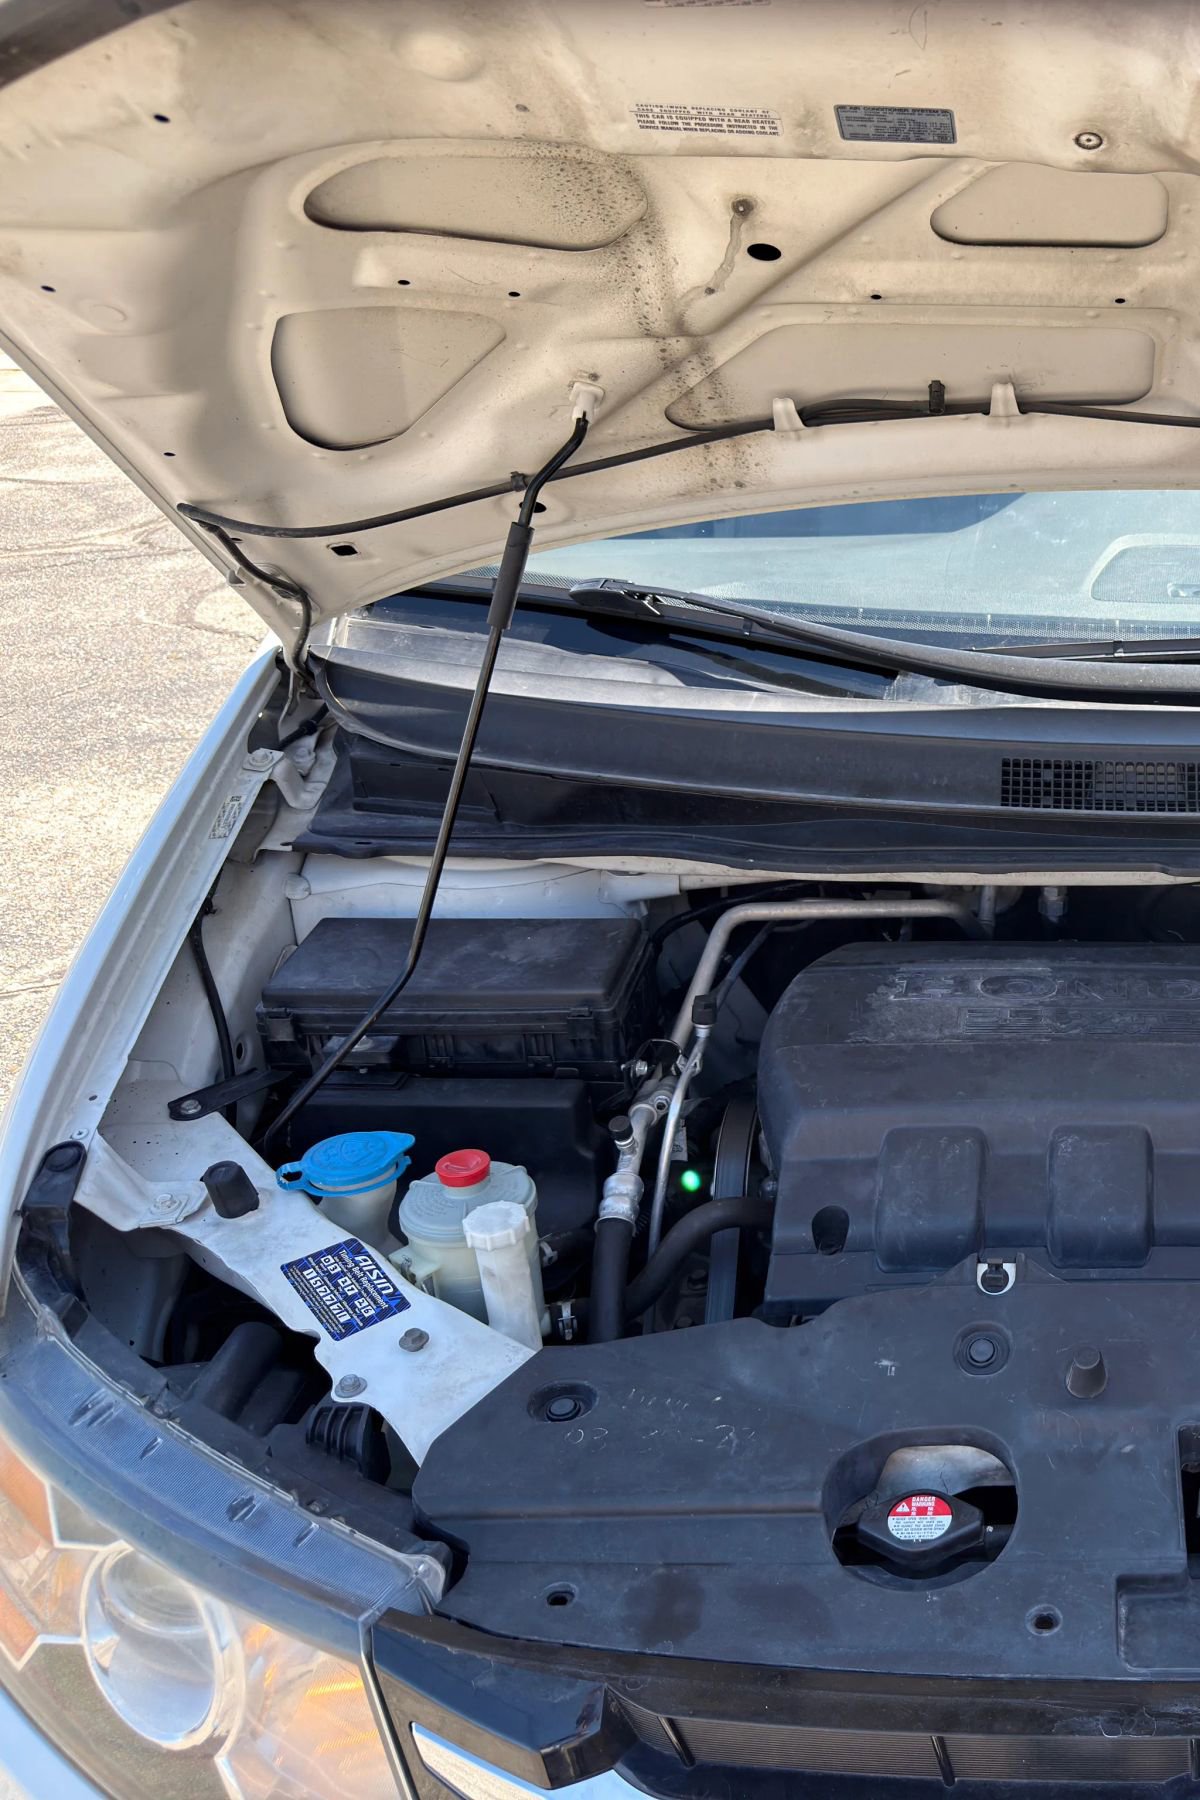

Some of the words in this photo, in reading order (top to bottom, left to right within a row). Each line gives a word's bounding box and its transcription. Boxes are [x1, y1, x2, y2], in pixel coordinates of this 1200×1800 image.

[339, 1249, 355, 1268] Timing
[351, 1265, 365, 1280] Belt
[360, 1275, 389, 1310] Replacement
[354, 1255, 394, 1295] AISIN
